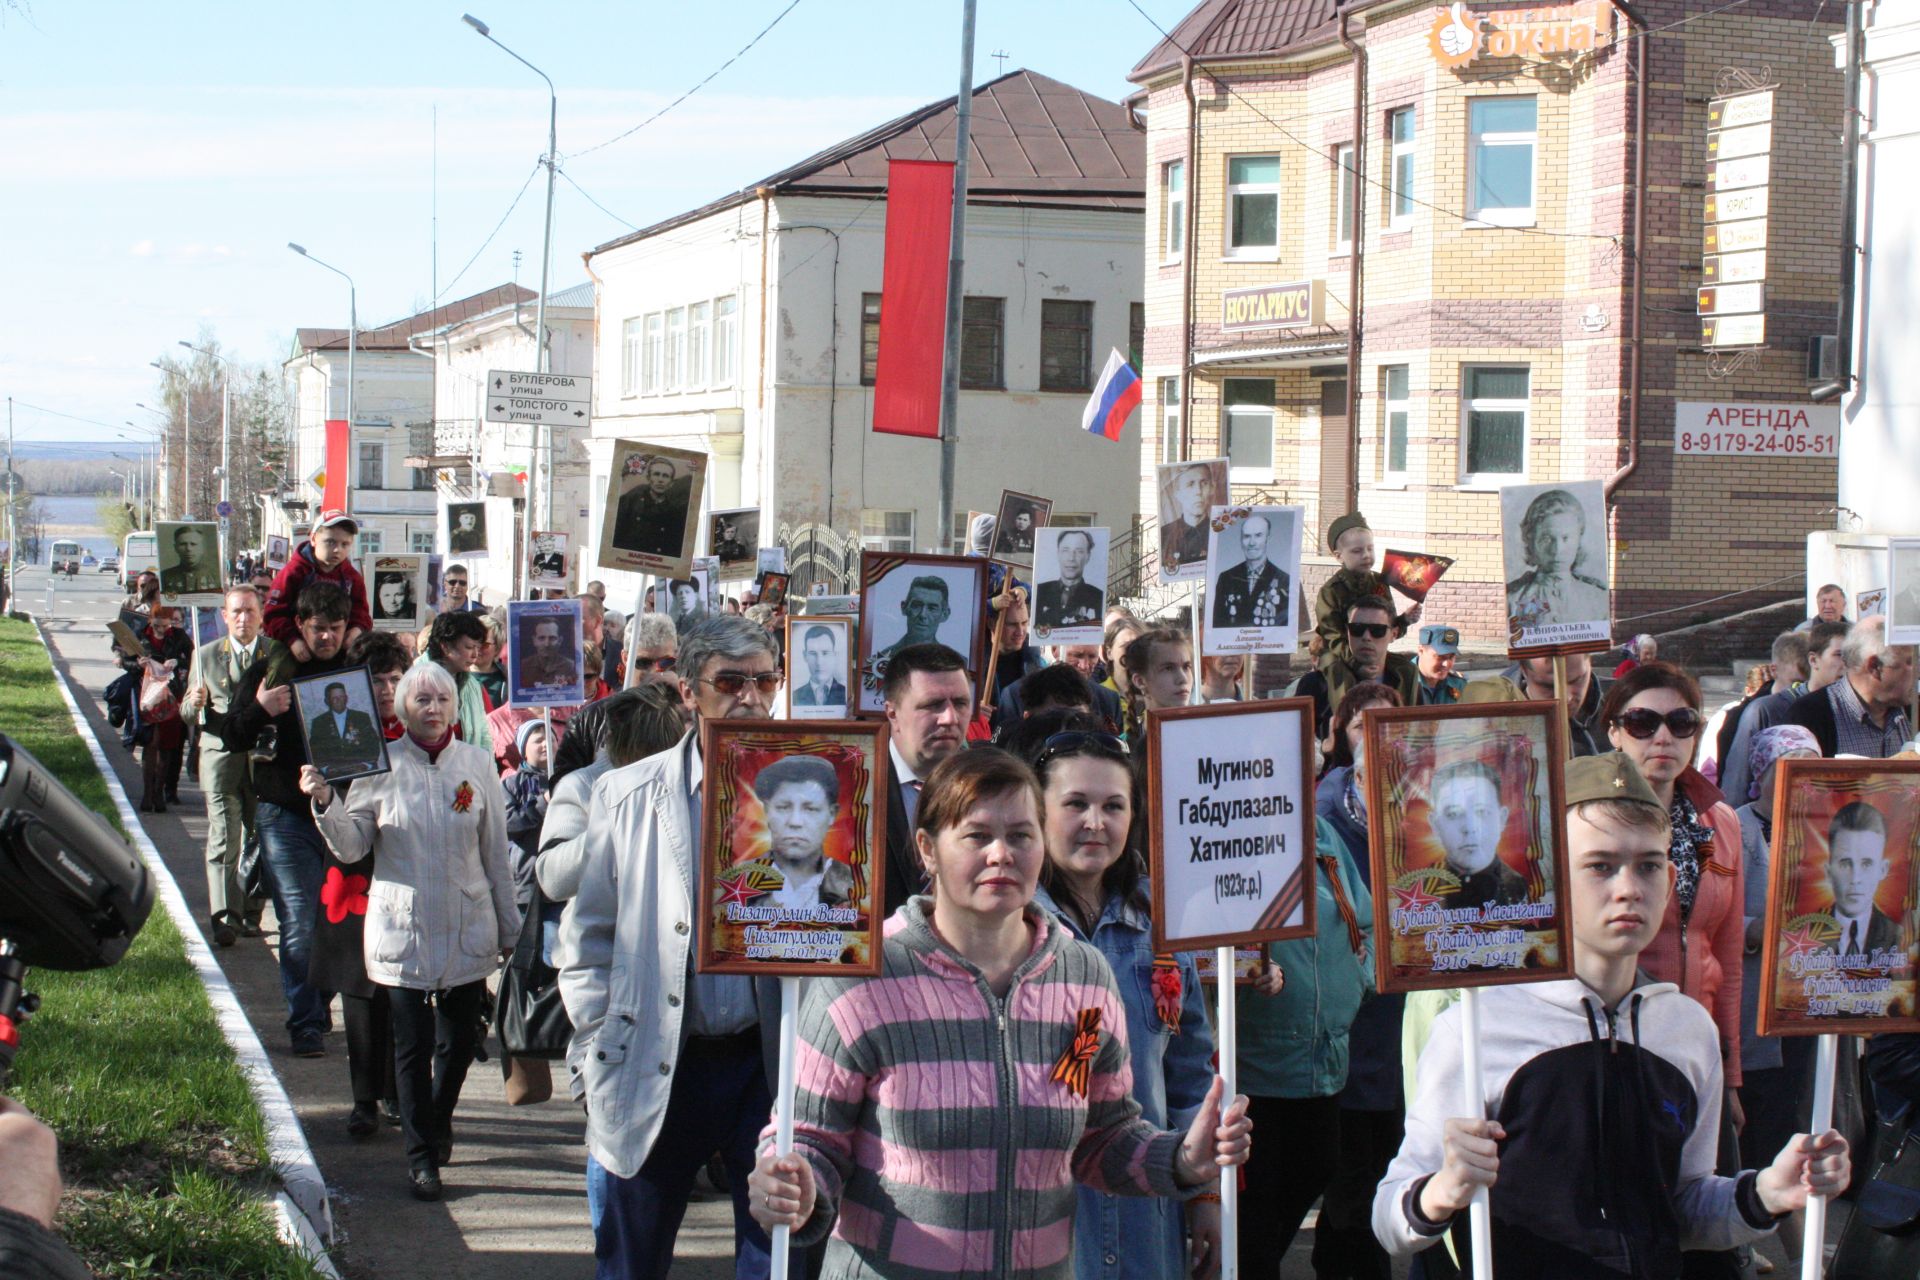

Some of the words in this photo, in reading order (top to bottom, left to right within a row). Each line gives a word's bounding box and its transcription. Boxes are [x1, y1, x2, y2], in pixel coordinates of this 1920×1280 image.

[1727, 196, 1753, 212] ЮРИСТ
[1226, 289, 1308, 324] НОТАРИУС
[510, 374, 575, 387] БУТЛЕРОВА
[511, 386, 543, 395] улица
[509, 399, 568, 411] ТОЛСТОГО
[509, 411, 542, 421] улица
[1706, 407, 1810, 431] АРЕНДА
[1681, 432, 1834, 453] 8-9179-24-05-51
[1198, 757, 1274, 790] Мугинов
[1179, 795, 1294, 828] Габдулазаль
[1190, 833, 1286, 864] Хатипович
[1214, 870, 1262, 904] (1923г.р.)
[728, 902, 814, 927] Гизатуллин
[815, 903, 858, 923] Вагиз
[1392, 902, 1480, 934] Губайдуллин
[1479, 900, 1554, 925] Хасангата
[744, 925, 843, 947] Гизатуллович
[1424, 926, 1525, 953] Губайдуллович
[745, 946, 772, 958] 1915
[783, 946, 840, 959] 15.01.1944
[1432, 954, 1469, 971] 1916
[1482, 950, 1519, 967] 1941
[1807, 997, 1839, 1015] 1911
[1852, 998, 1884, 1014] 1941
